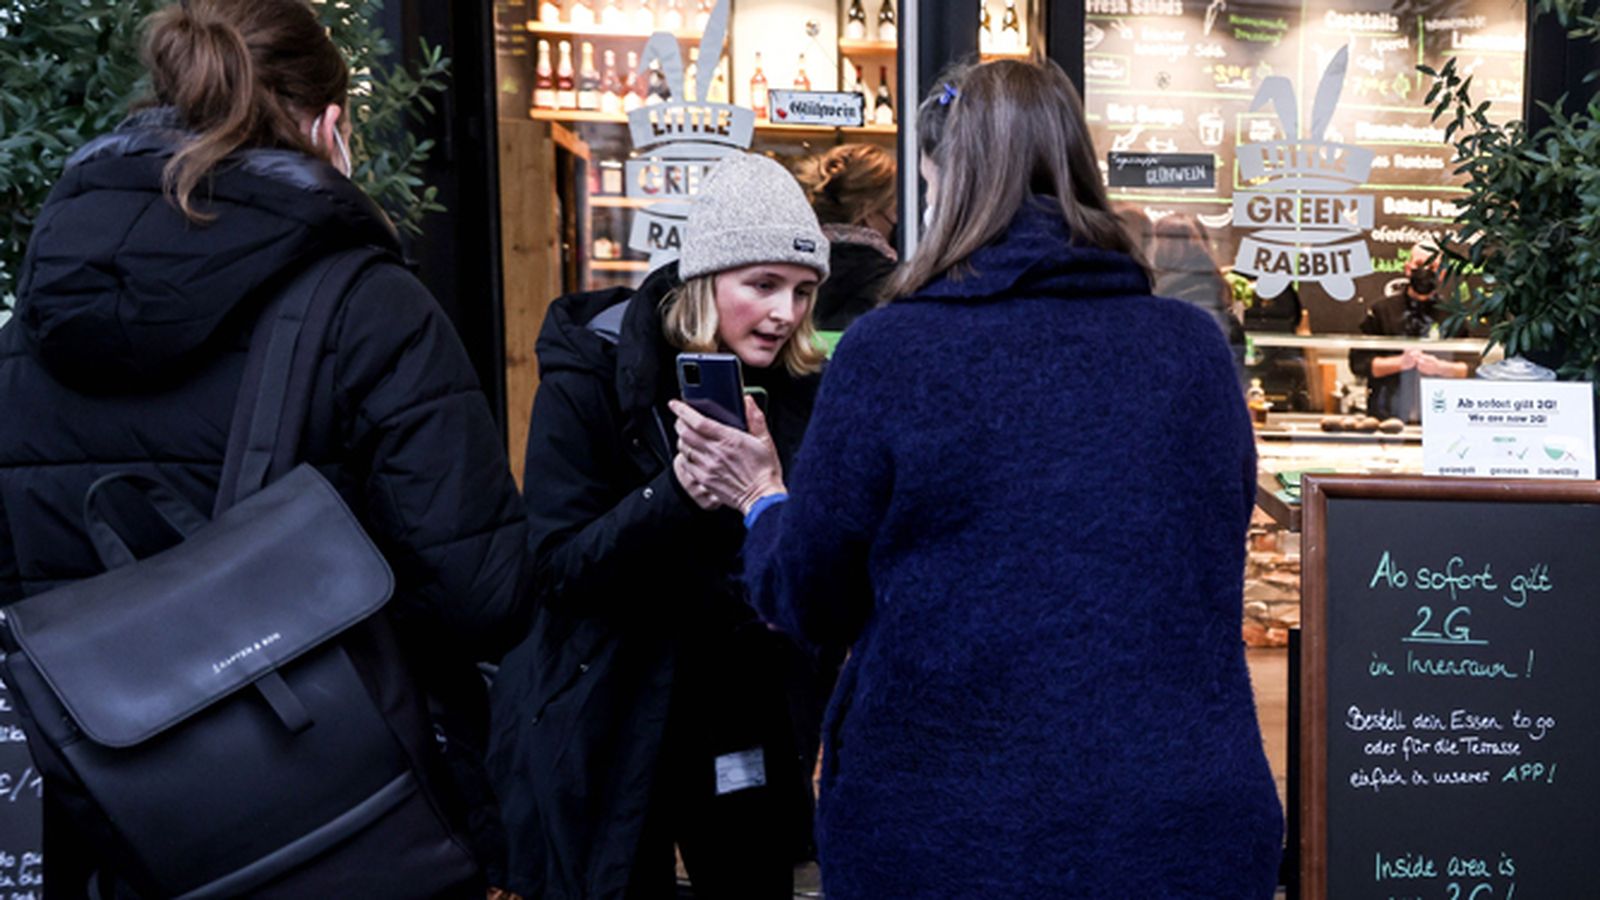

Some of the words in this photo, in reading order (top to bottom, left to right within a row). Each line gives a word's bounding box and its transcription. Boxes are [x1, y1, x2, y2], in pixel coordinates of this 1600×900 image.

[649, 106, 732, 137] LITTLE
[1246, 195, 1359, 225] GREEN
[1253, 247, 1352, 276] RABBIT
[1457, 398, 1474, 409] Ab
[1369, 550, 1409, 589] Ab
[1415, 556, 1498, 601] sofort
[1503, 563, 1553, 608] gilt
[1411, 606, 1471, 641] 2G
[1345, 704, 1407, 731] Bestell
[1412, 712, 1447, 731] dein
[1450, 709, 1504, 731] Essen
[1512, 709, 1532, 729] to
[1528, 716, 1555, 741] go
[1364, 740, 1398, 755] oder
[1402, 735, 1431, 762] für
[1434, 738, 1459, 755] die
[1459, 736, 1521, 755] Terrasse
[1350, 767, 1407, 792] einfach
[1433, 771, 1490, 785] unserer
[1375, 852, 1438, 881] Inside
[1446, 856, 1492, 878] area
[1498, 852, 1516, 877] is
